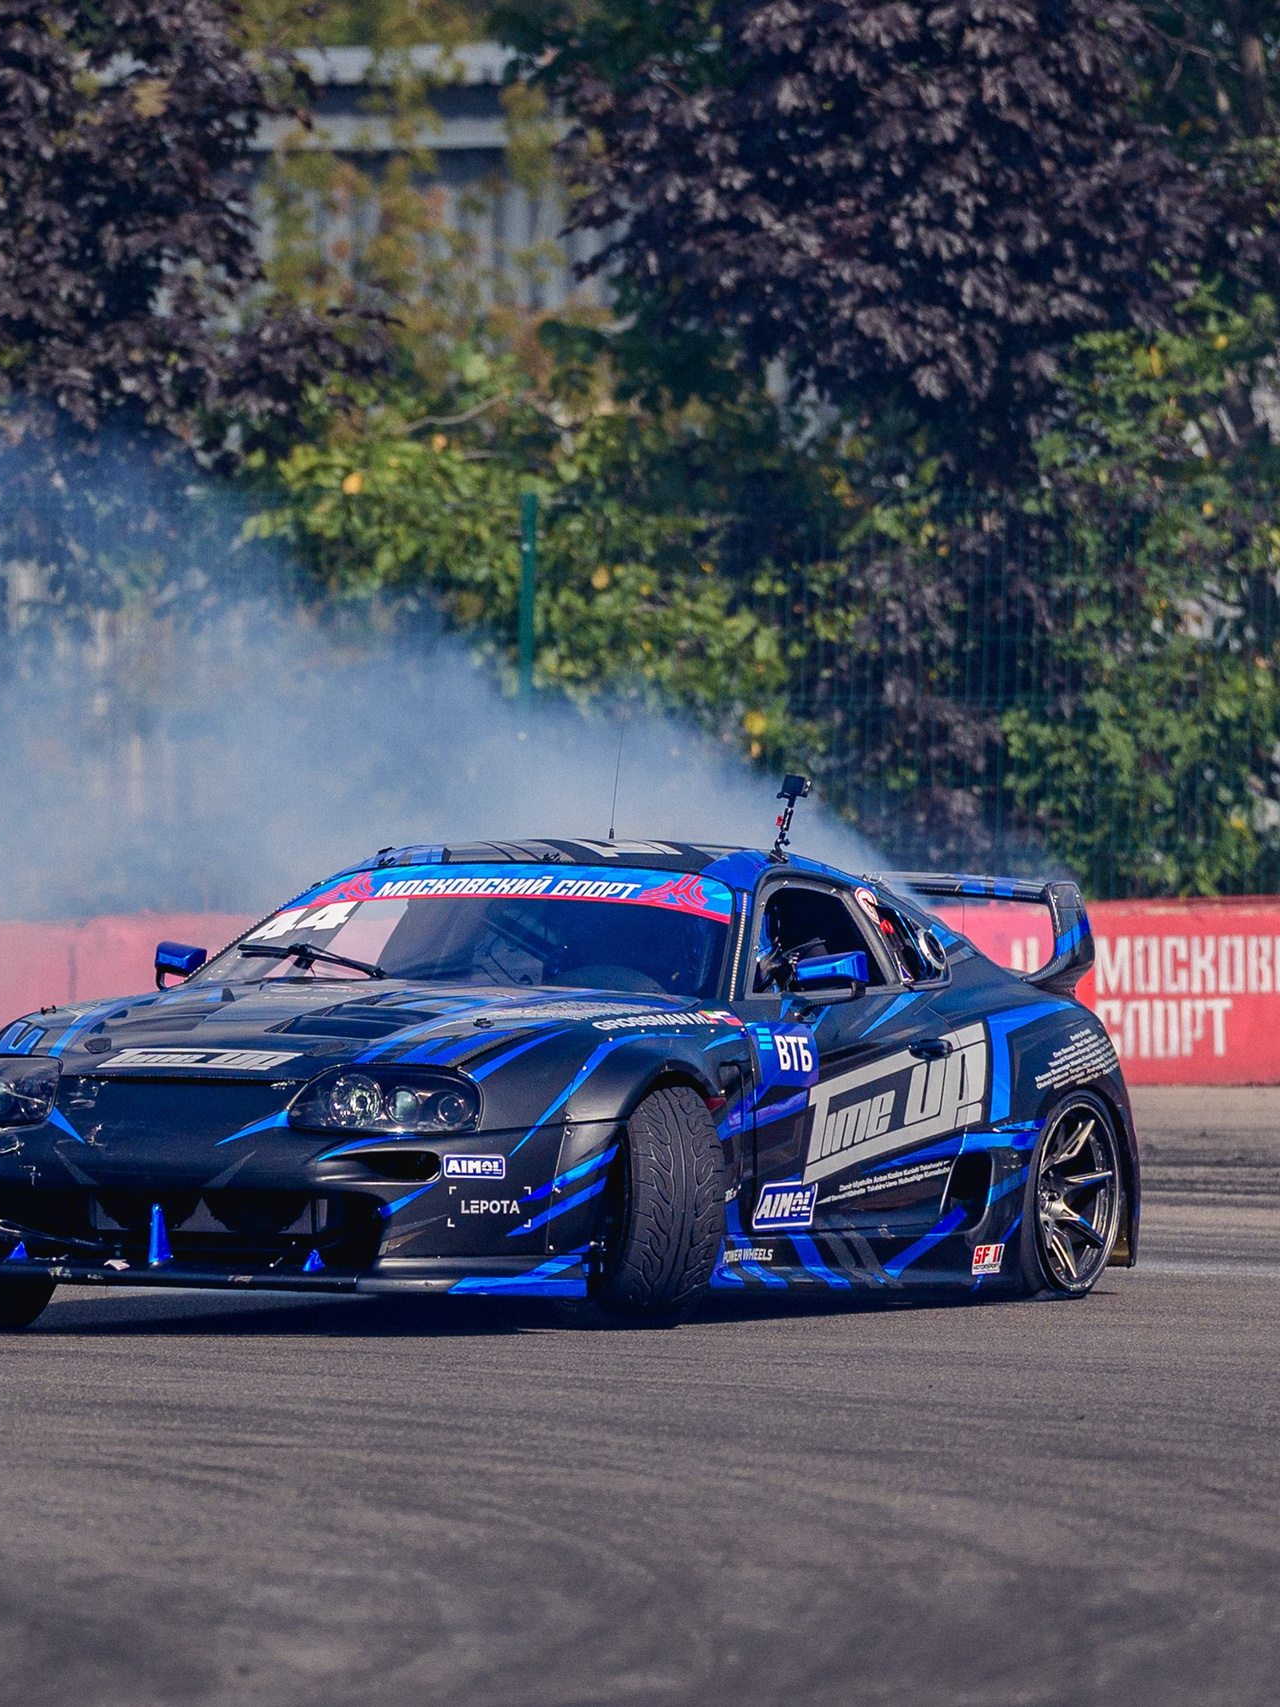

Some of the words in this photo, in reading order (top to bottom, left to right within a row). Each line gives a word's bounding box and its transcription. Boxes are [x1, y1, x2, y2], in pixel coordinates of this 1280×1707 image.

[374, 875, 554, 898] МОСКОВСКИЙ
[551, 879, 642, 899] СПОРТ
[244, 901, 358, 941] 44
[592, 1013, 693, 1031] GROSSMAN
[1094, 997, 1233, 1058] СПОРТ
[773, 1034, 813, 1072] ВТБ
[446, 1159, 502, 1174] AIMOL
[460, 1200, 521, 1214] LEPOTA
[756, 1190, 811, 1219] AIMOL
[723, 1249, 742, 1263] POWER
[742, 1248, 774, 1262] WHEELS
[973, 1246, 991, 1265] SF
